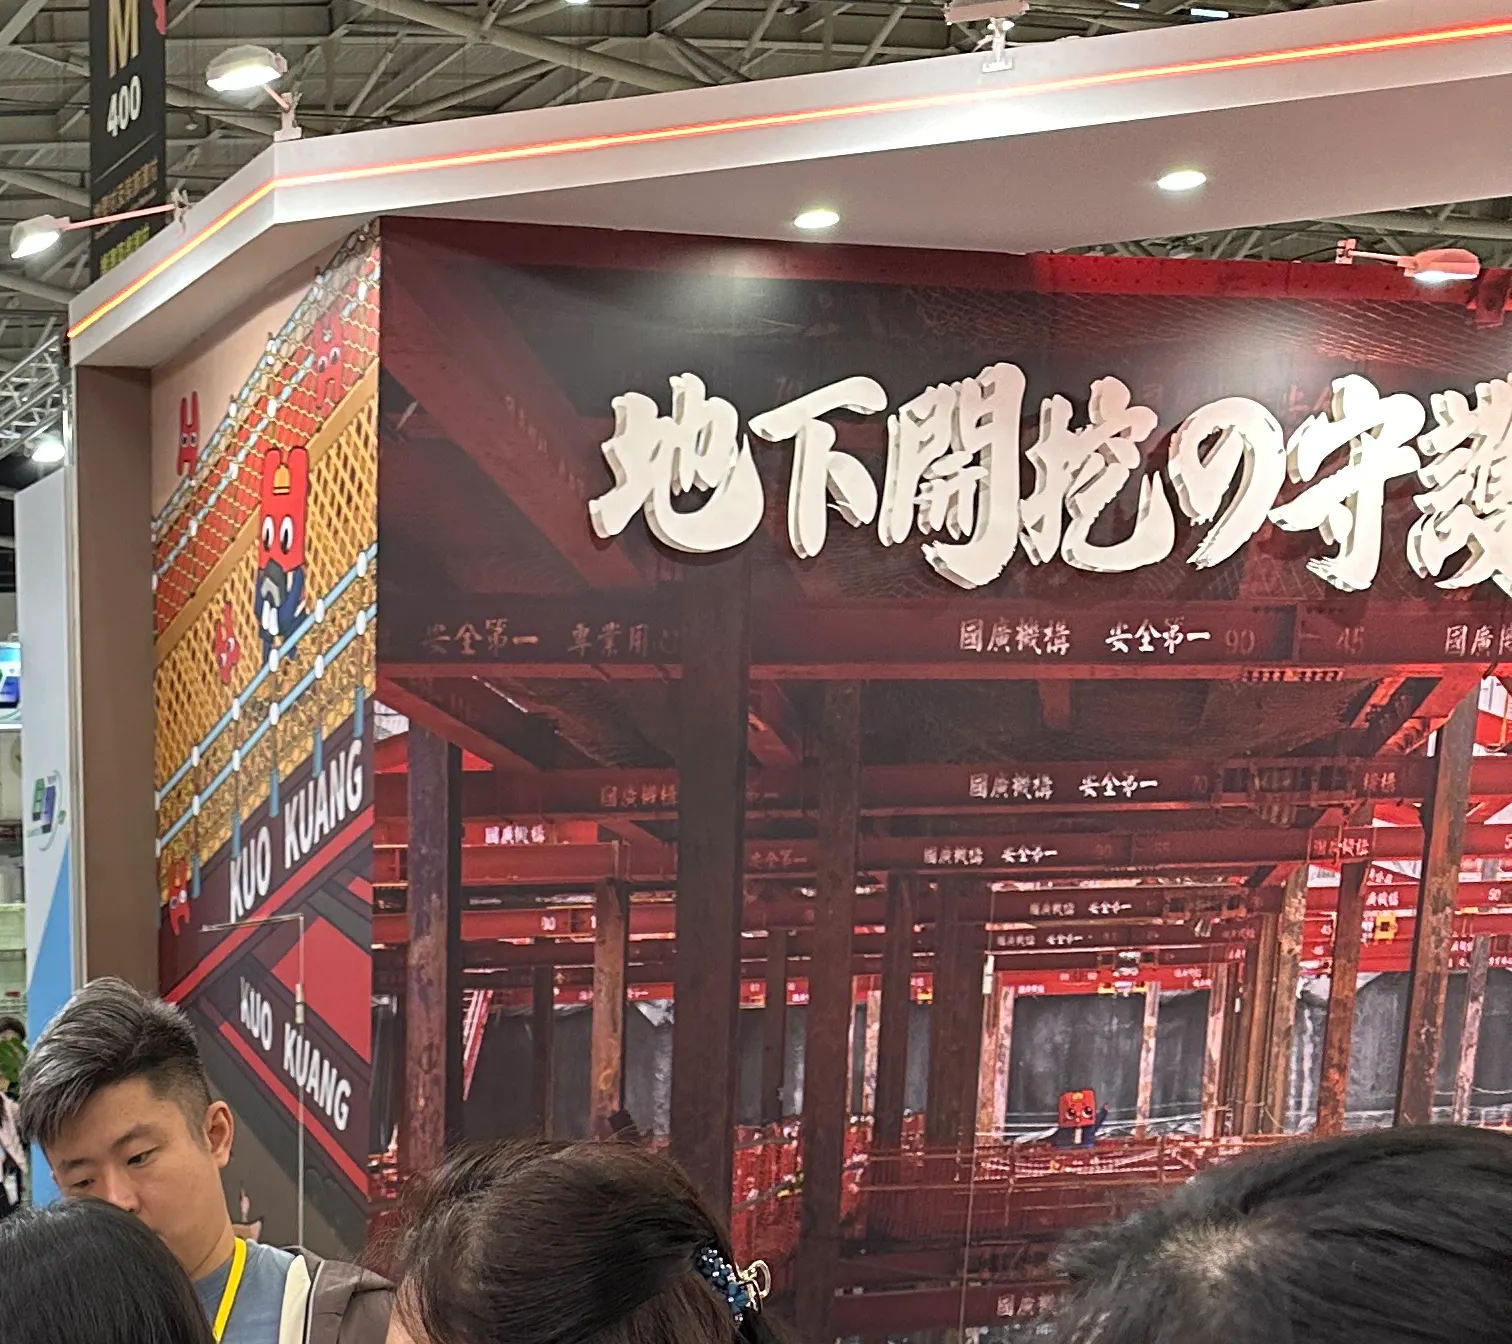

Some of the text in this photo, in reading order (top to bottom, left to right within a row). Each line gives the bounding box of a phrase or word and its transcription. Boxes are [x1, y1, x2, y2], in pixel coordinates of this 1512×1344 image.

[107, 75, 142, 137] 400
[1105, 616, 1212, 654] 安全第一
[229, 739, 364, 924] KUO KUANG
[239, 976, 352, 1131] KUO KUANG
